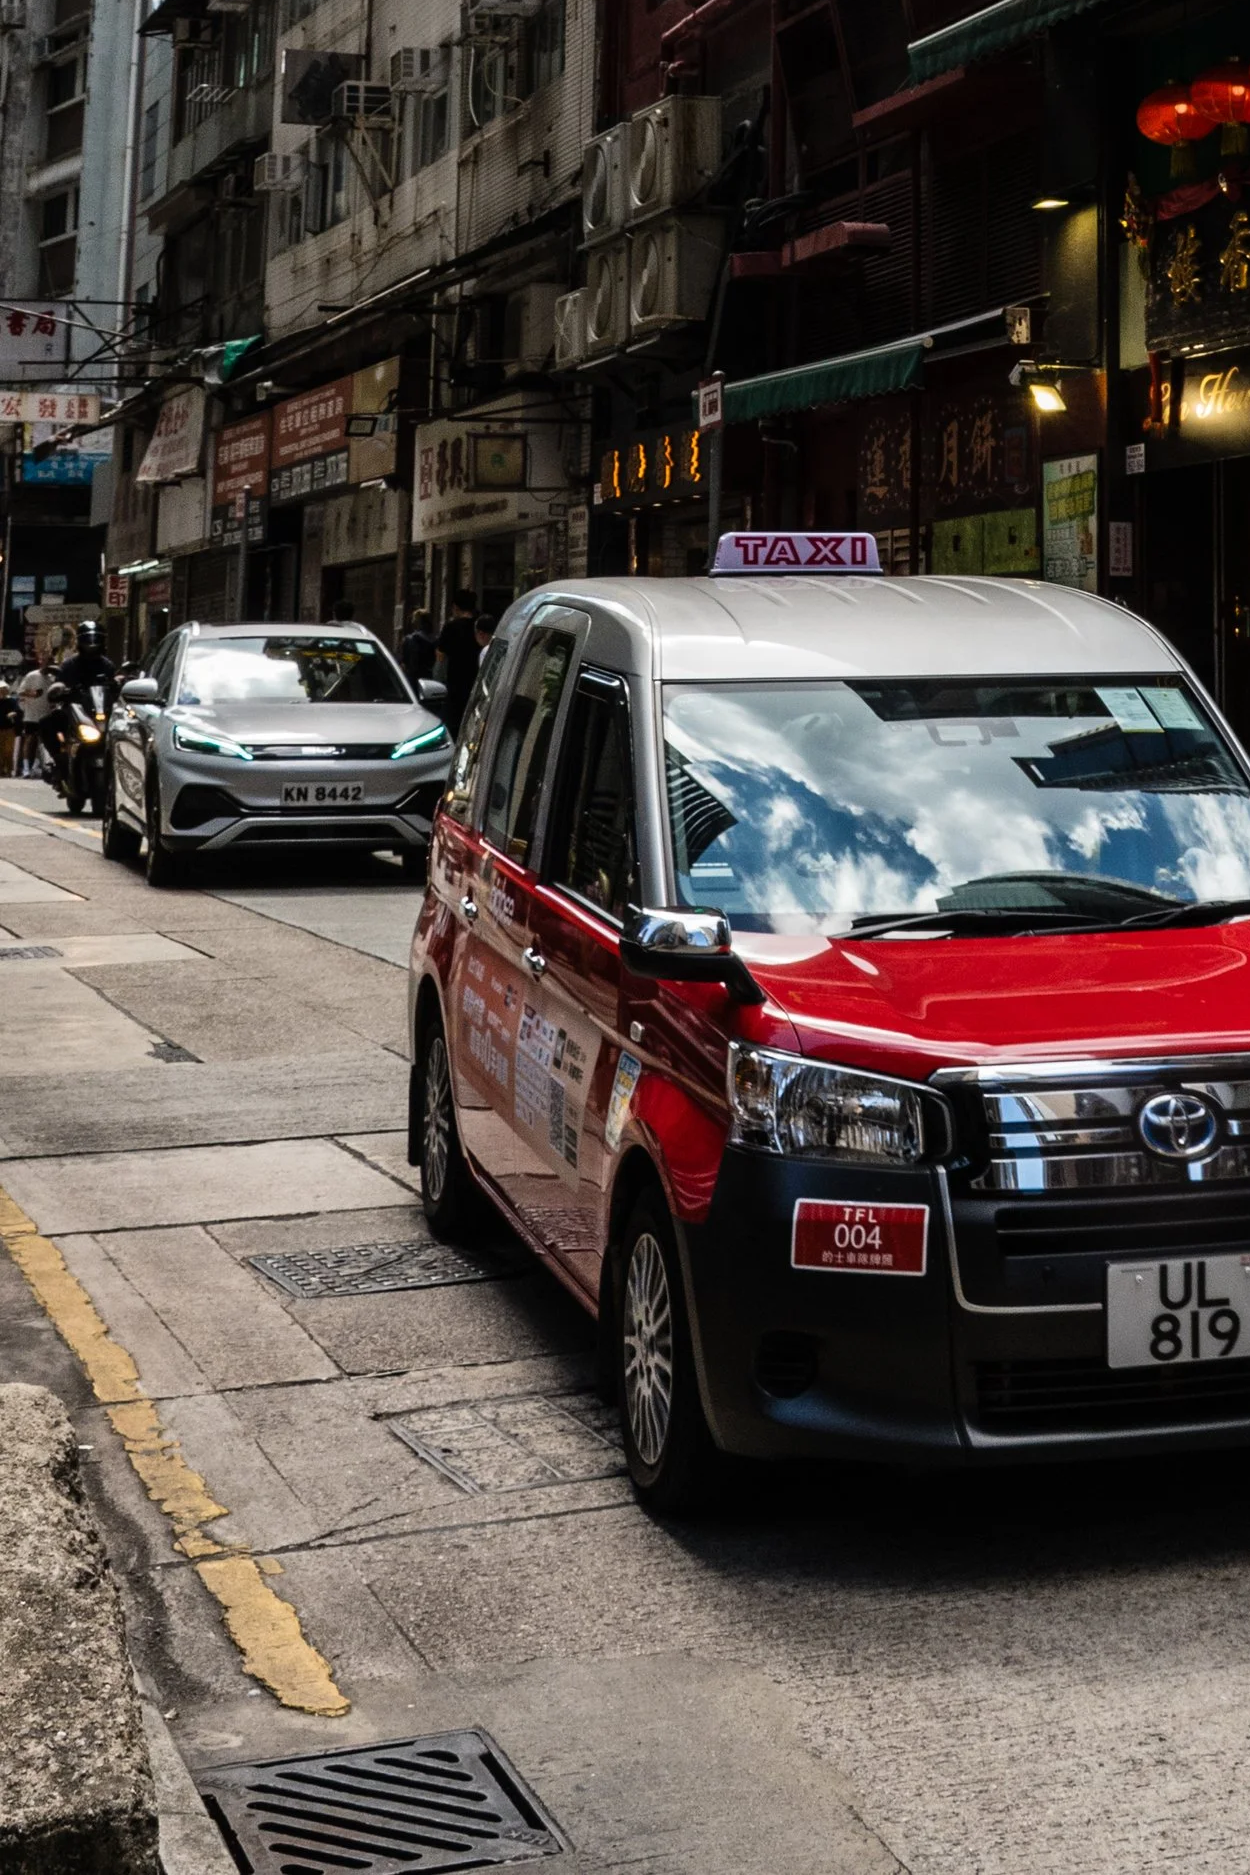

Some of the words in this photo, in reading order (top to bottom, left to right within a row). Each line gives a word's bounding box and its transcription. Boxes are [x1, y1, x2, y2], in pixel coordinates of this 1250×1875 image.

[734, 536, 868, 566] TAXI
[284, 787, 309, 802] KN
[314, 786, 363, 801] 8442
[843, 1207, 878, 1223] TFL
[834, 1223, 883, 1250] 004
[1159, 1261, 1231, 1310] UL
[1149, 1308, 1241, 1362] 819
